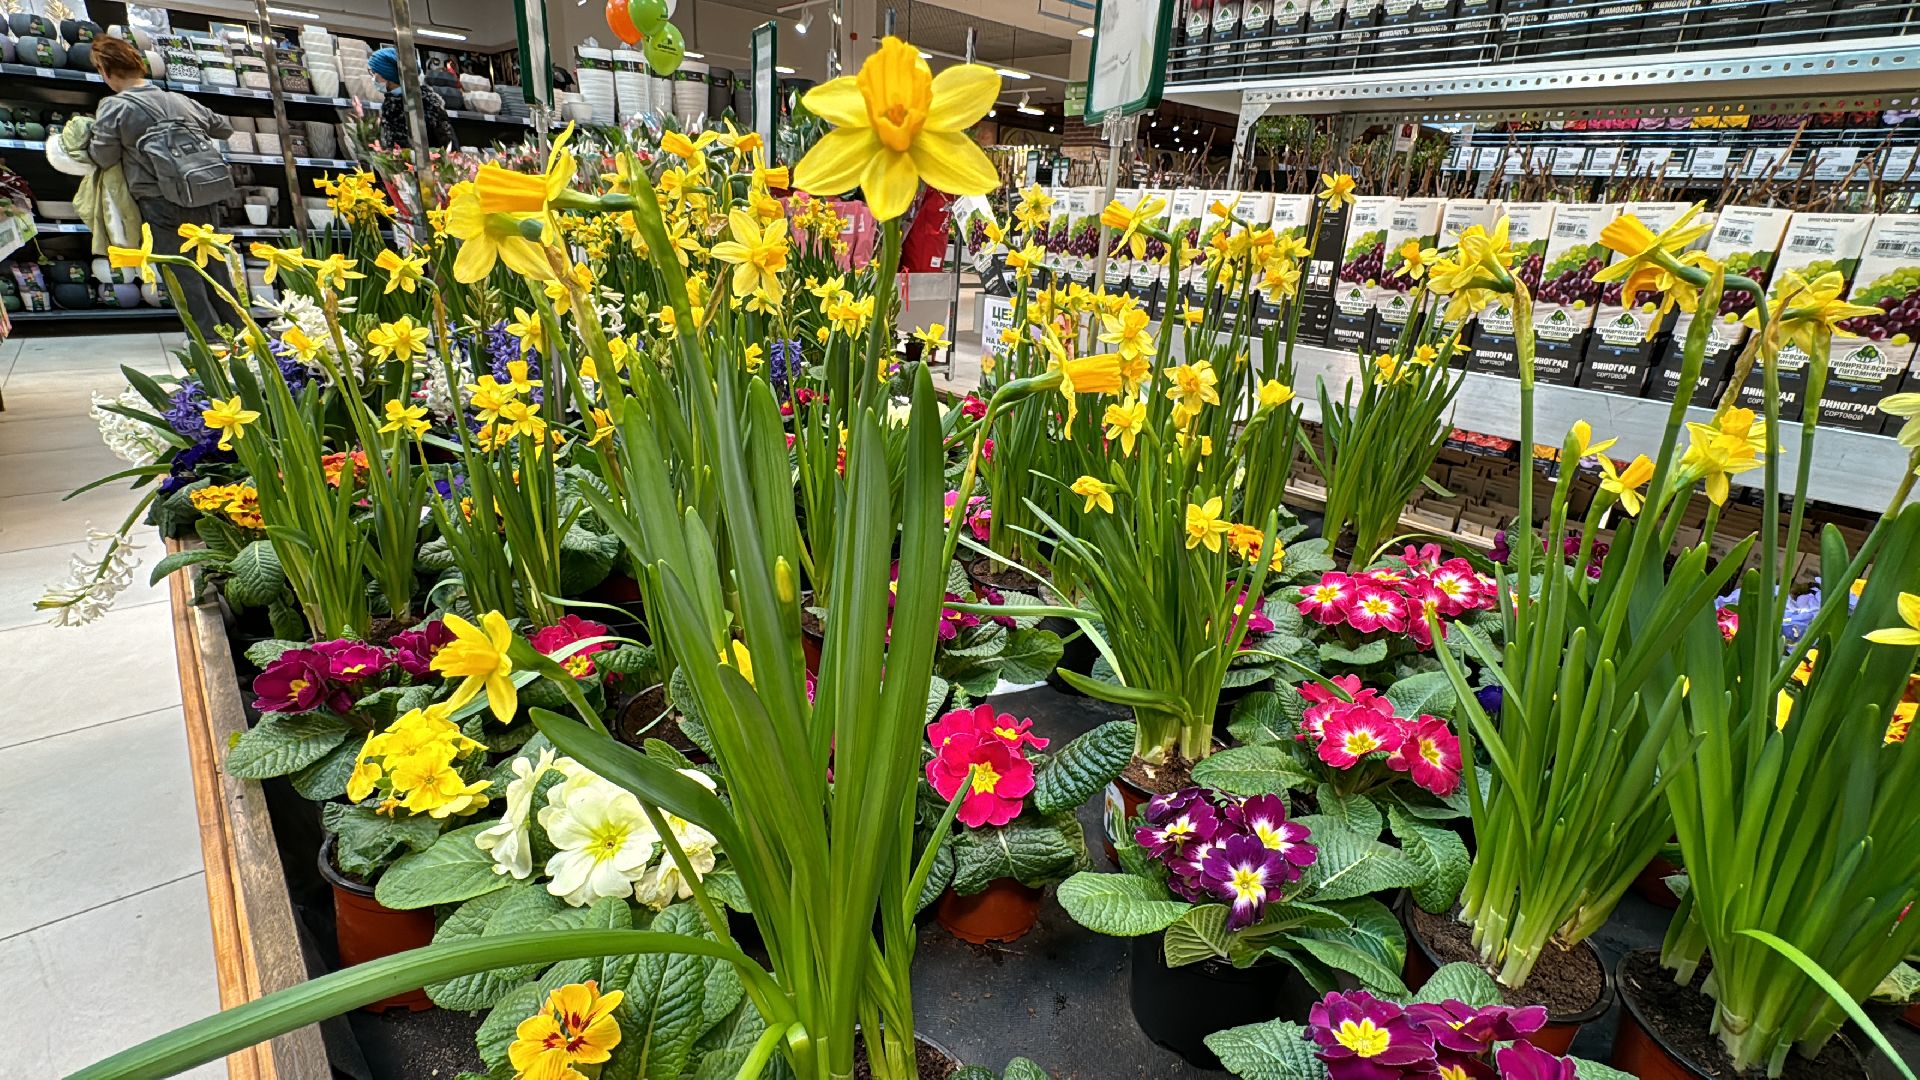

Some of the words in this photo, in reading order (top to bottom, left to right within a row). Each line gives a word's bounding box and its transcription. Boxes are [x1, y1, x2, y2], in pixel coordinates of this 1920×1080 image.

[1547, 10, 1588, 20] ЖИМОЛОСТЬ
[1598, 4, 1643, 15] ЖИМОЛОСТЬ
[1475, 350, 1513, 362] ВИНОГРАД
[1533, 357, 1569, 369] ИНОГРАД
[1591, 361, 1637, 375] ВИНОГРАД
[1830, 360, 1898, 373] ТИМИРЯЗЕВСКИЙ
[1838, 367, 1883, 378] ПИТОМНИК
[1742, 386, 1796, 403] ВИНАД
[1818, 398, 1877, 416] ВИНОГРАД
[1824, 409, 1864, 421] СОРТОВОЙ
